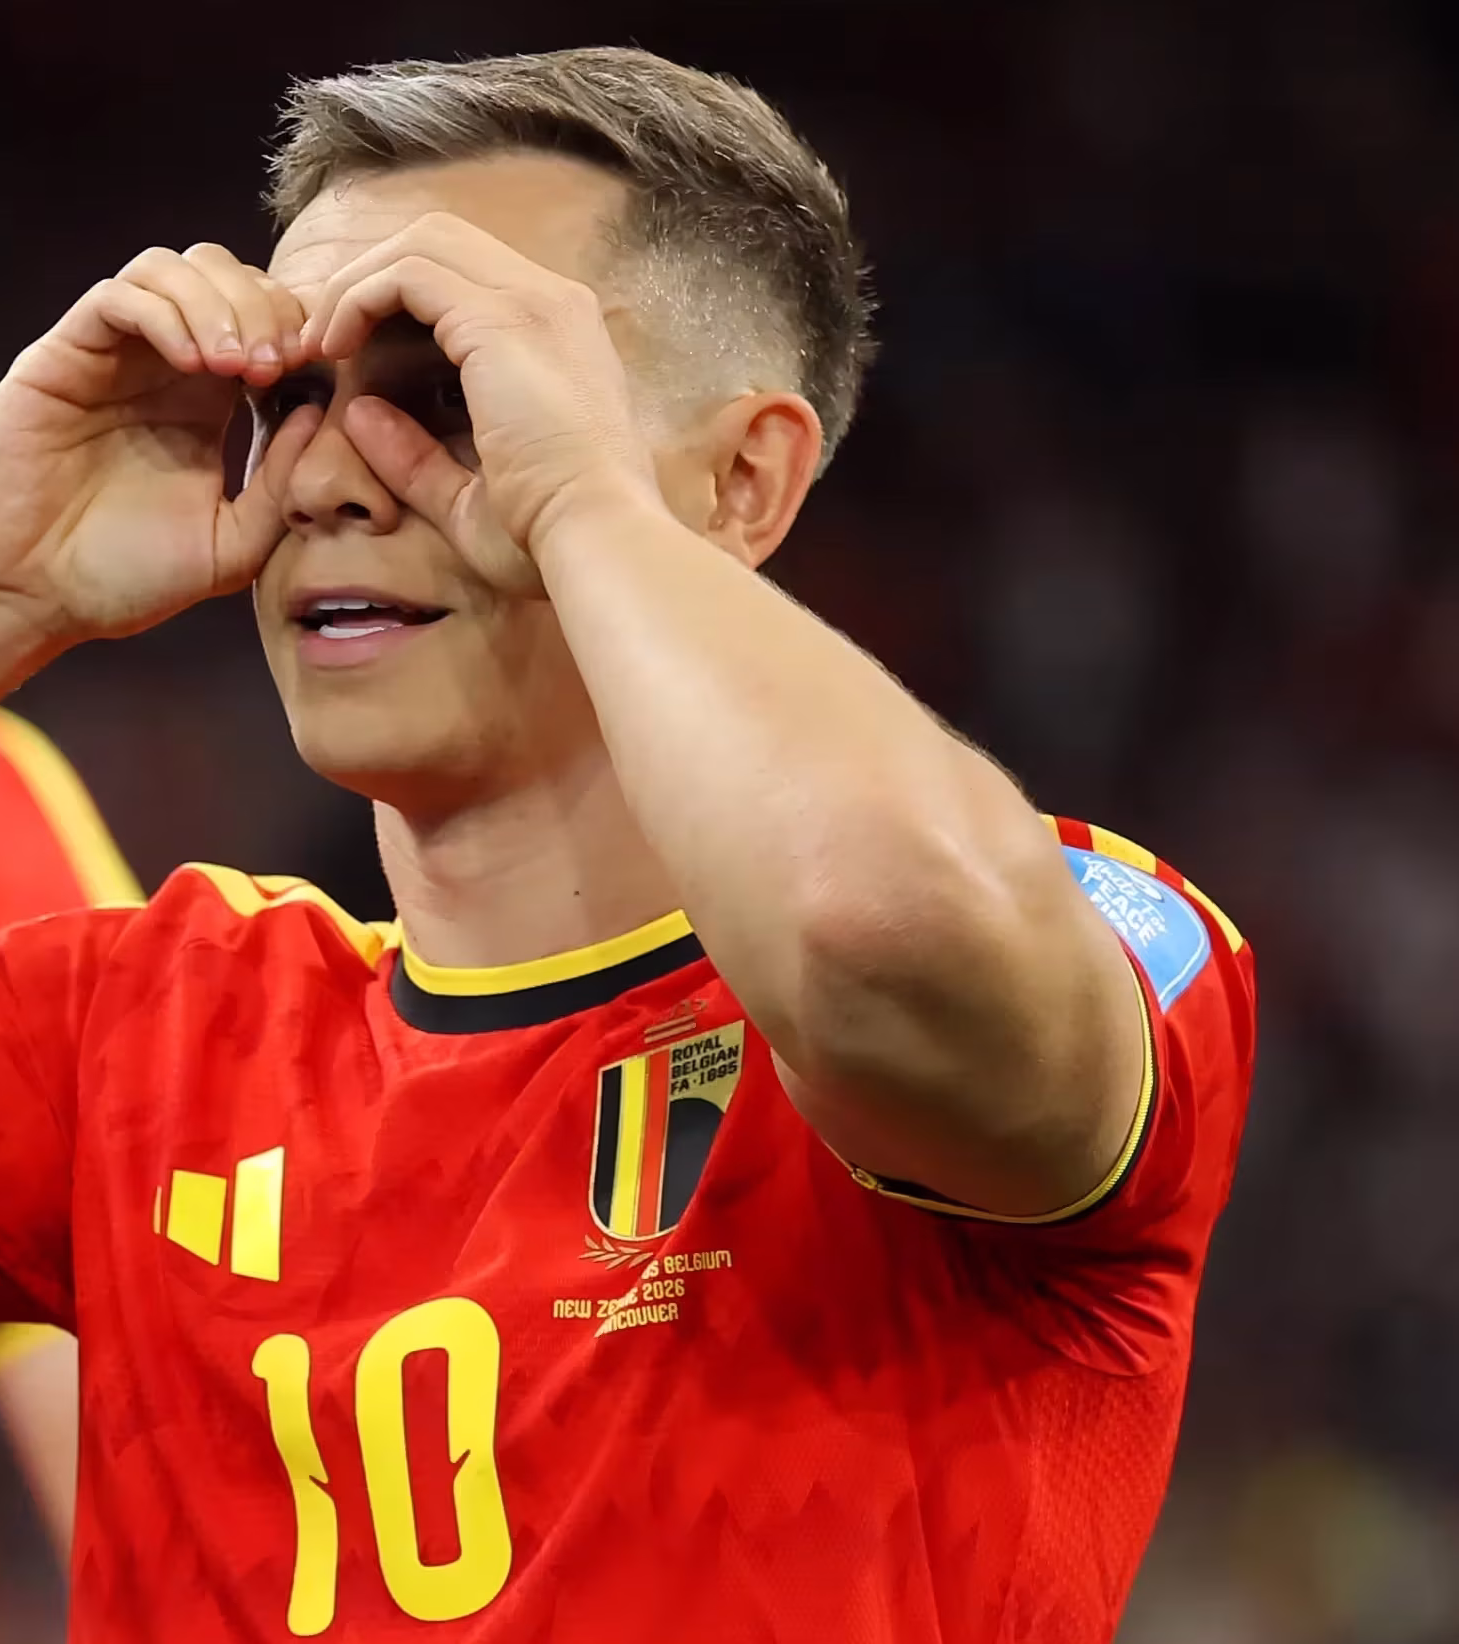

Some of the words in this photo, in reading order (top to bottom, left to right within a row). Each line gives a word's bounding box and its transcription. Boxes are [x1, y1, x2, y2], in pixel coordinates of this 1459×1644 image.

[671, 1045, 739, 1080] BELGIAN
[672, 1035, 723, 1063] ROYAL
[670, 1078, 690, 1096] FA
[553, 1299, 592, 1319] NEW
[663, 1250, 733, 1274] BELGIUM
[642, 1278, 685, 1301] 2026
[251, 1296, 513, 1637] 10
